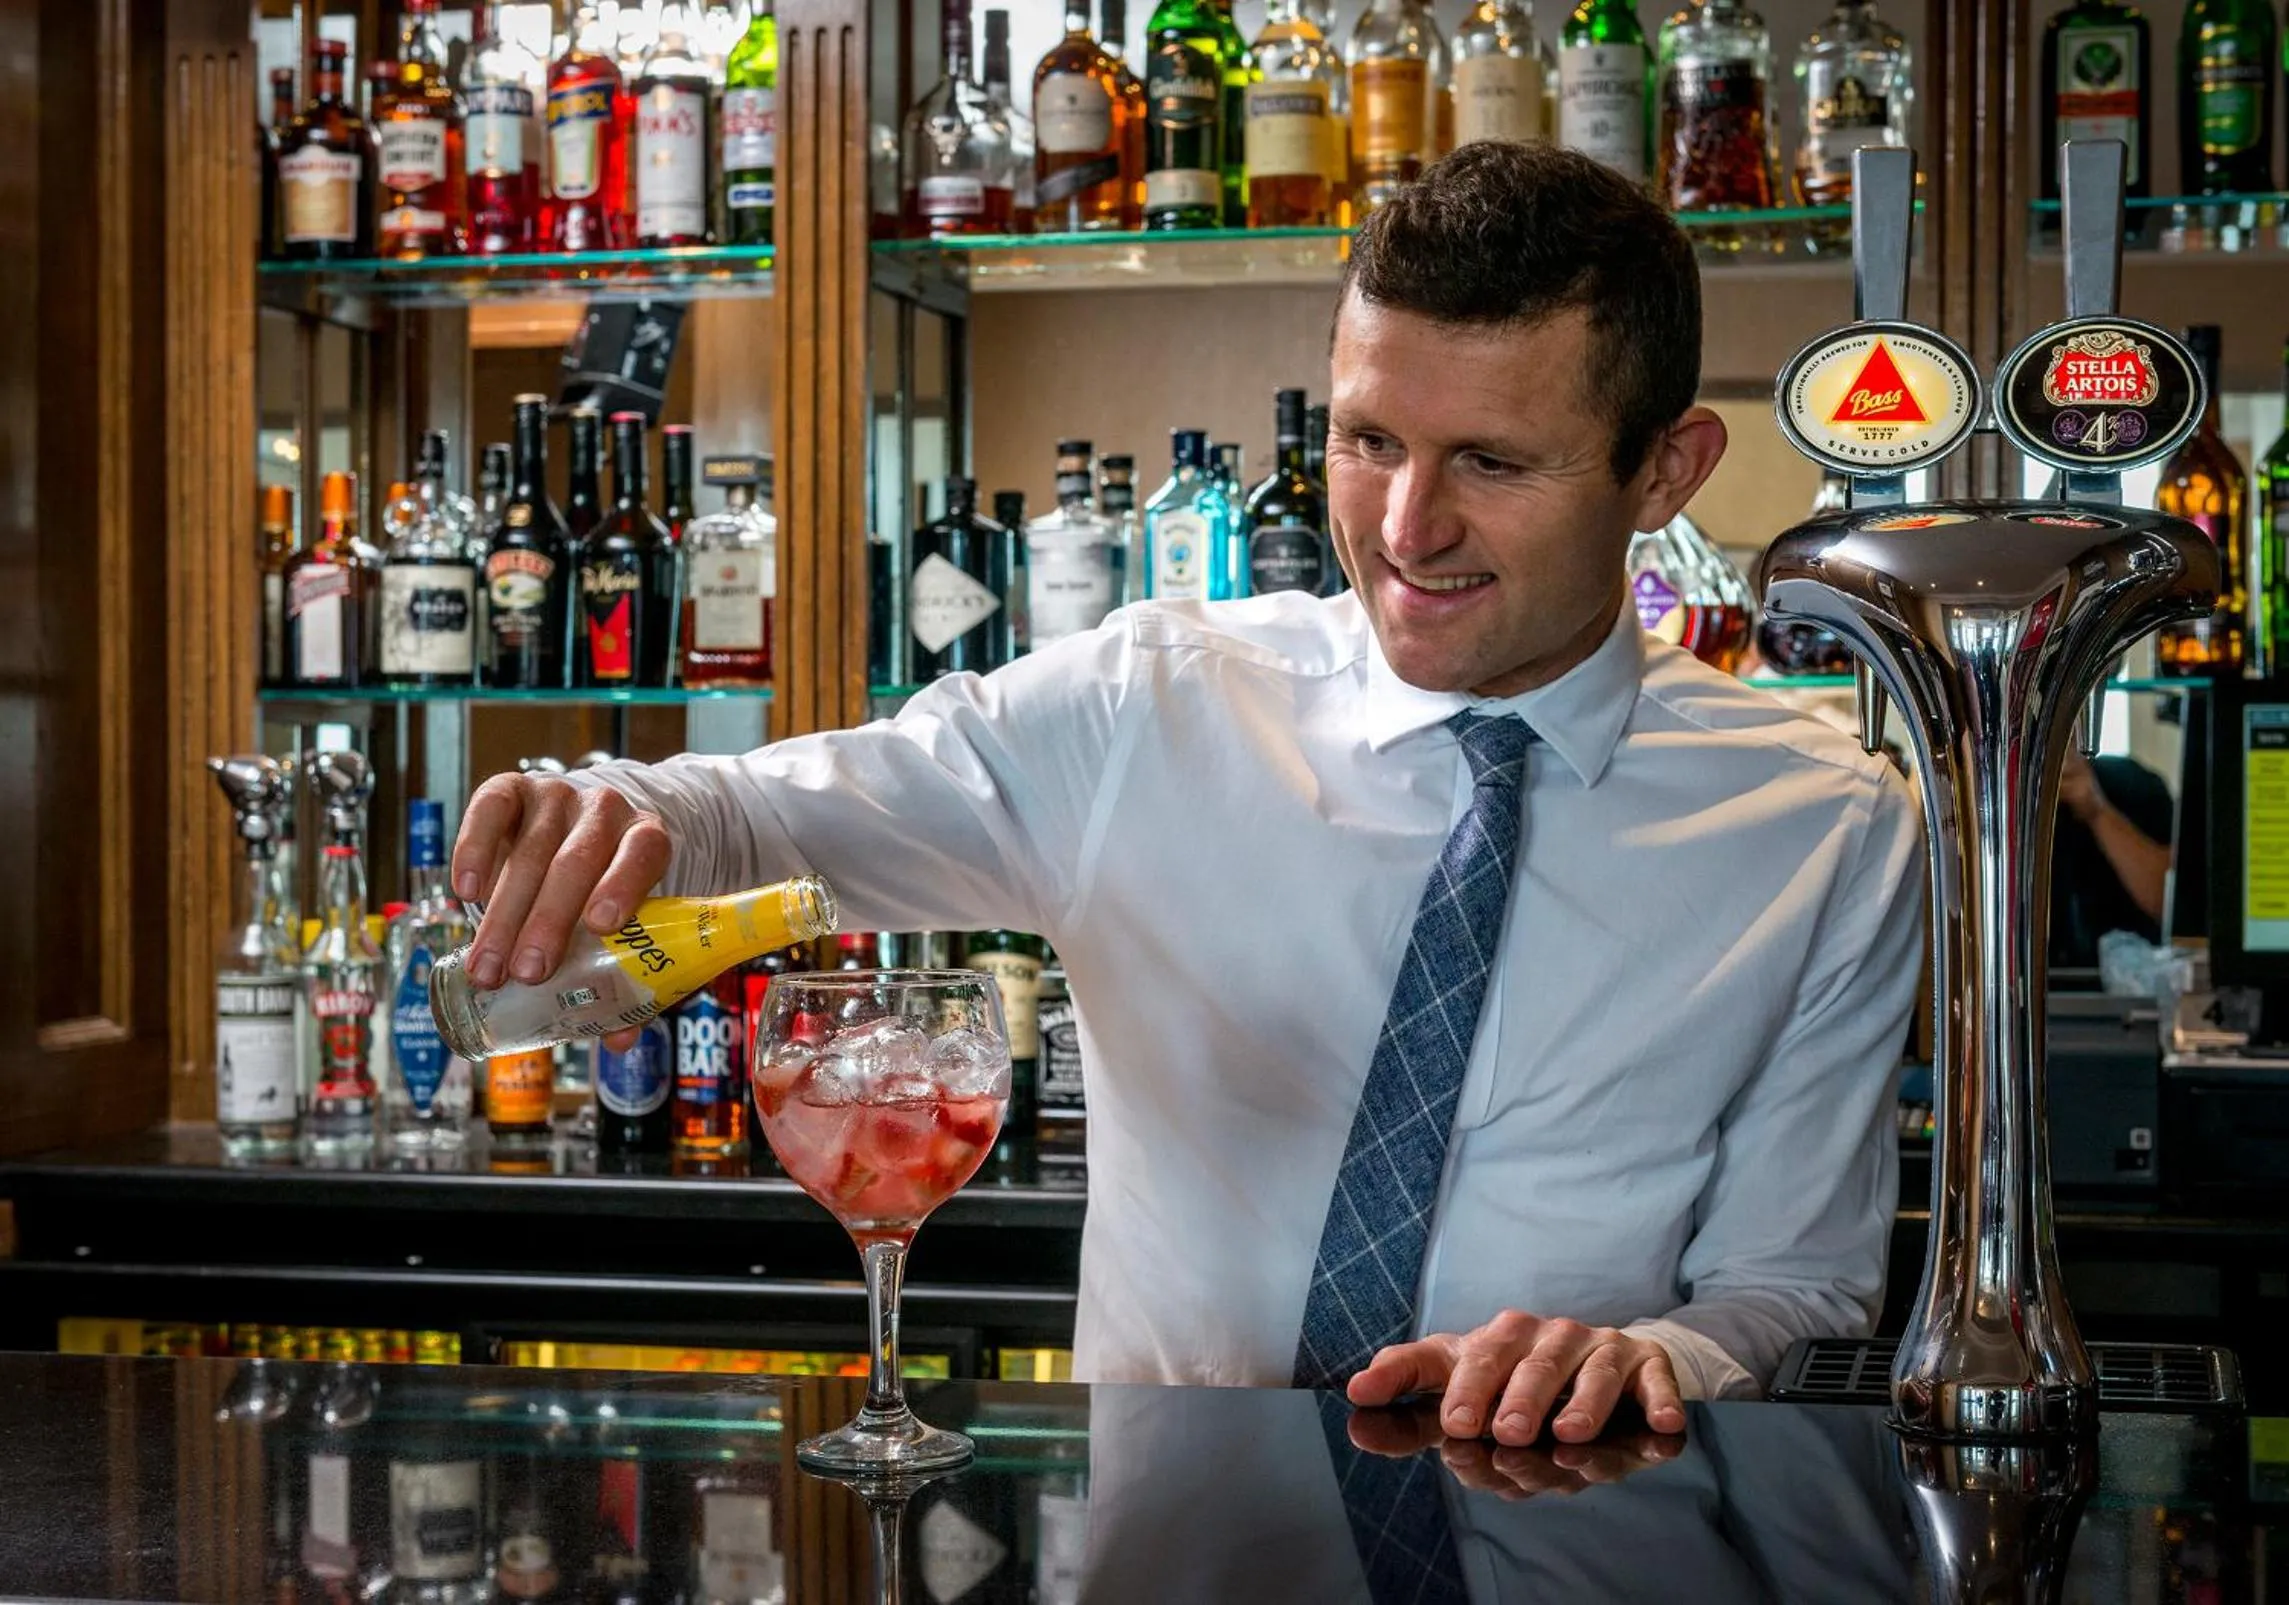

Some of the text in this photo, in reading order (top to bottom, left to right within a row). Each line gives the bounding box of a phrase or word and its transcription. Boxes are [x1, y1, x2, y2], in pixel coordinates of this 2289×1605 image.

[2066, 360, 2137, 375] STELLA
[2065, 377, 2138, 392] ARTOIS
[1849, 389, 1904, 416] Bass
[1863, 432, 1894, 440] 1777
[1828, 440, 1929, 457] SERVE COLD
[677, 1047, 731, 1076] BAR
